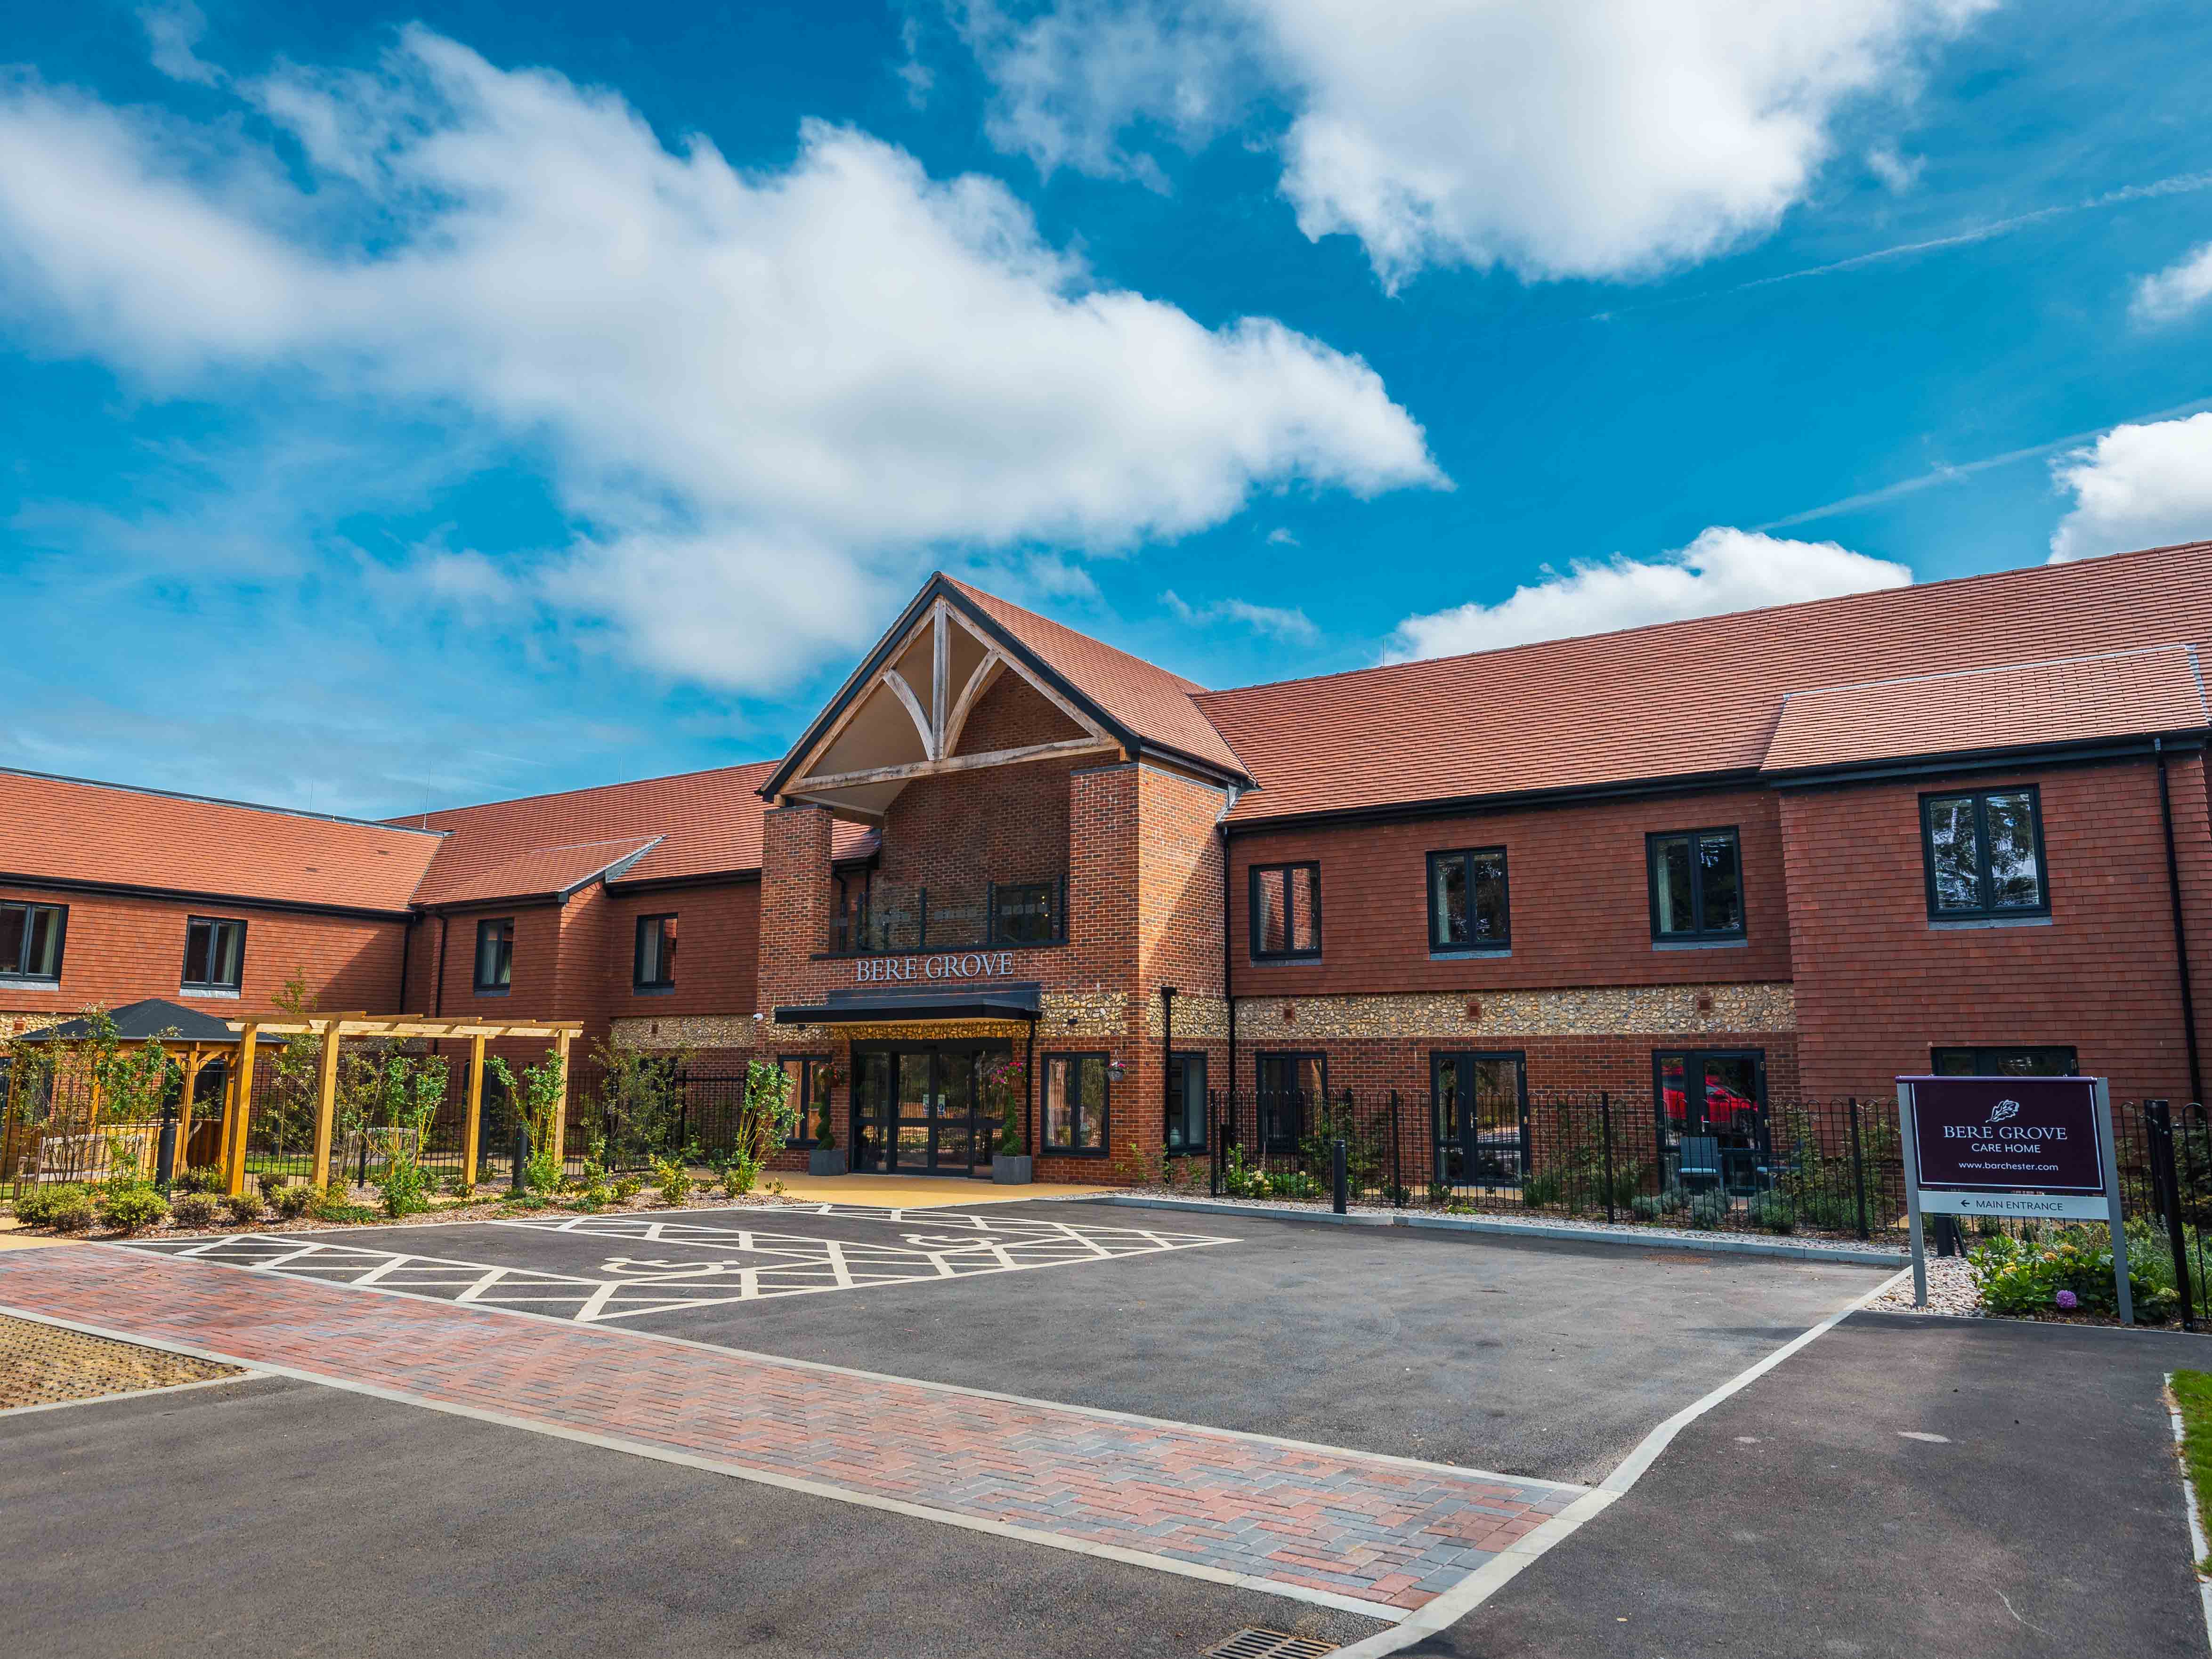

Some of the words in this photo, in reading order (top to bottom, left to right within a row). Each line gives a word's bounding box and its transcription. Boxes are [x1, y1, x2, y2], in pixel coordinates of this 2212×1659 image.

[856, 958, 917, 981] BERE
[926, 953, 1013, 979] GROVE
[1943, 1126, 1993, 1139] BERE
[1999, 1126, 2067, 1140] GROVE
[1971, 1143, 2002, 1152] CARE
[2005, 1144, 2041, 1153] HOME
[1959, 1161, 2058, 1171] www.barchester.com
[1976, 1200, 2003, 1208] MAIN
[2007, 1201, 2063, 1211] ENTRANCE
